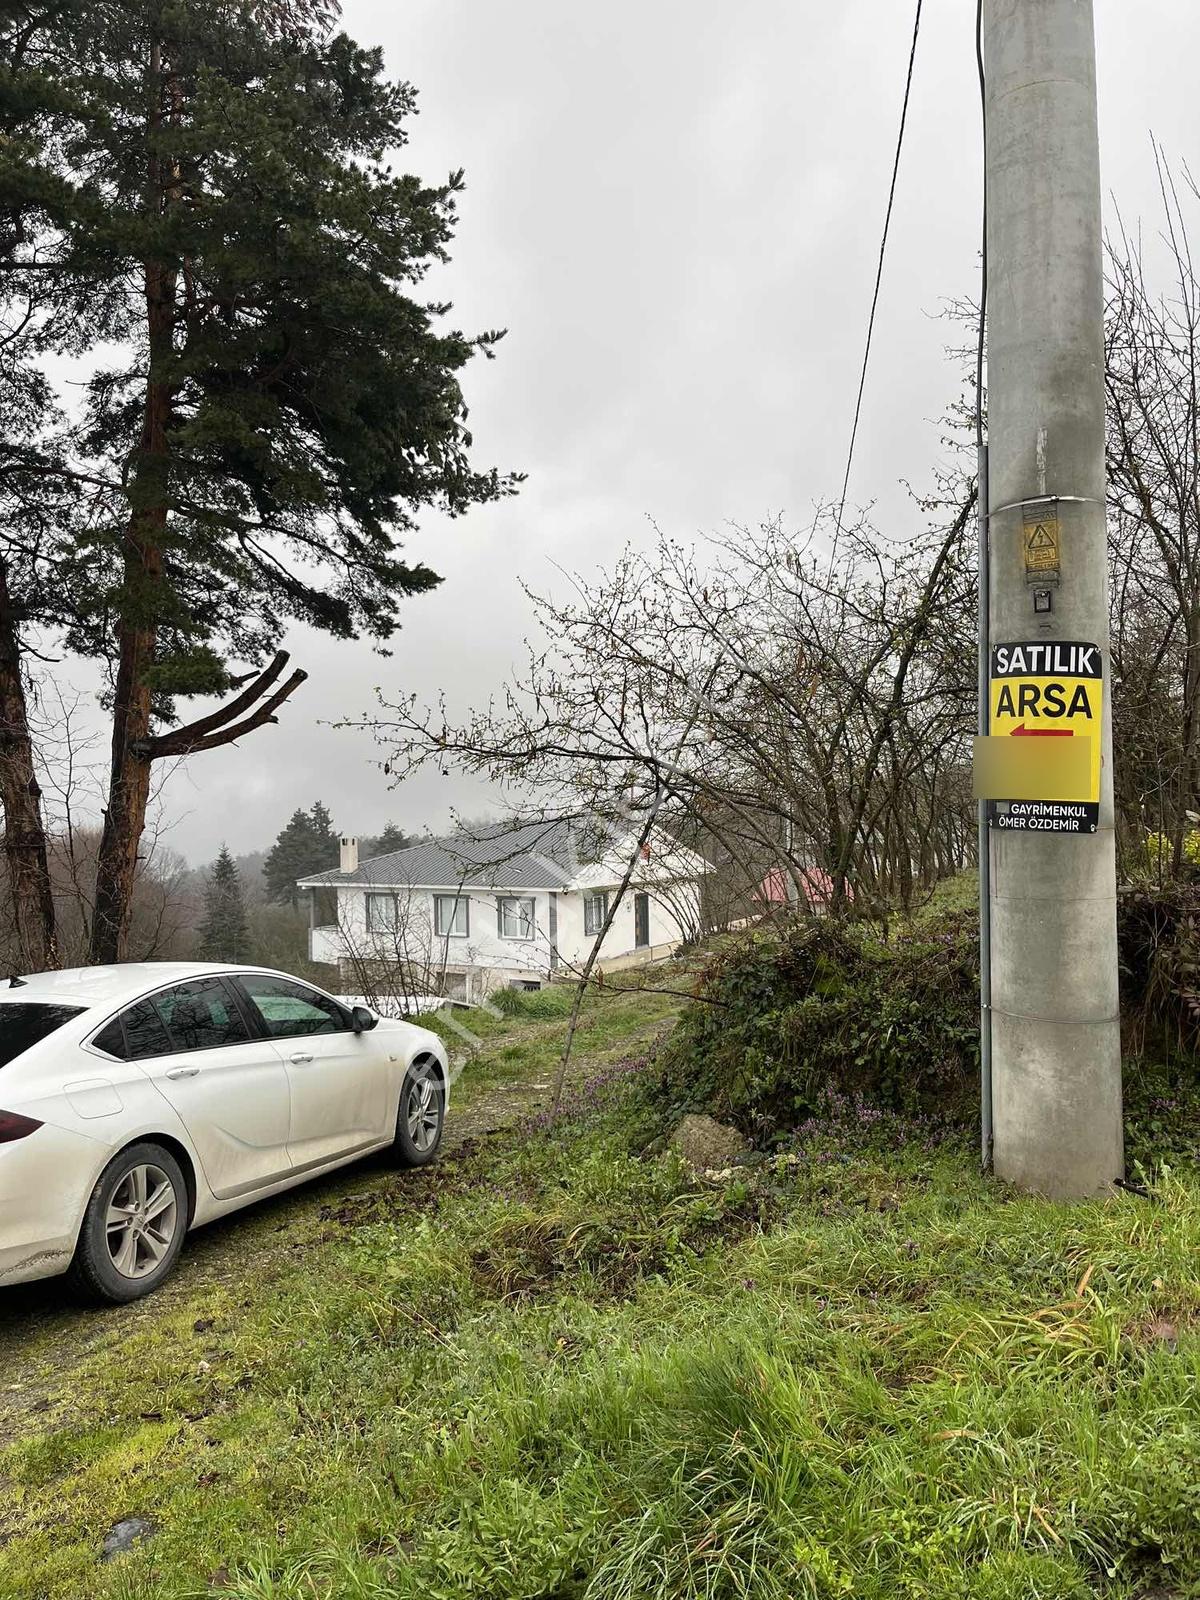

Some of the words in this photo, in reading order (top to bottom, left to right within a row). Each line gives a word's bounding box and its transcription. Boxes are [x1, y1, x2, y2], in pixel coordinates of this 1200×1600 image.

[996, 646, 1094, 674] SATILIK
[997, 684, 1092, 718] ARSA
[1010, 802, 1087, 817] GAYRİMENKUL
[998, 815, 1026, 828] ÖMER
[1028, 817, 1080, 831] ÖZDEMİR
